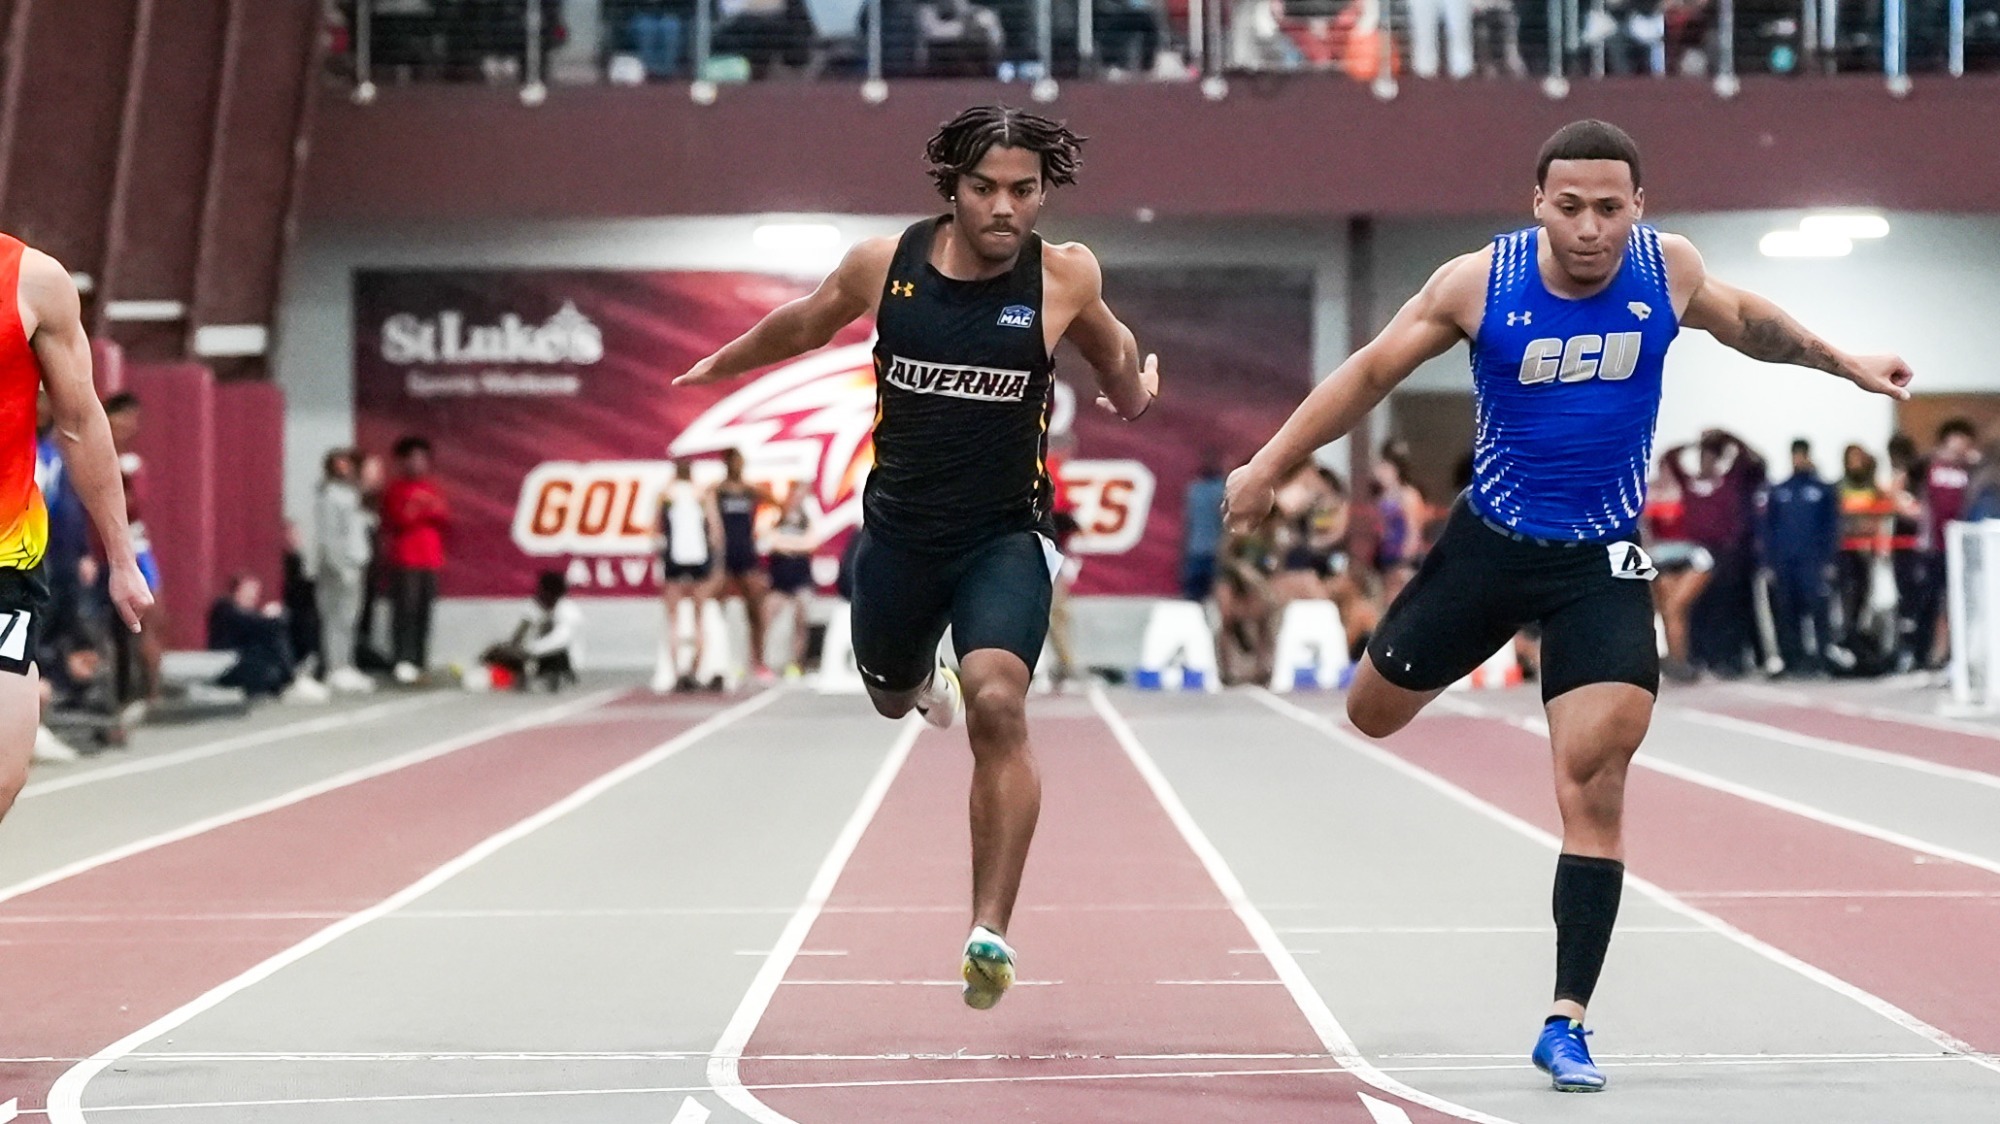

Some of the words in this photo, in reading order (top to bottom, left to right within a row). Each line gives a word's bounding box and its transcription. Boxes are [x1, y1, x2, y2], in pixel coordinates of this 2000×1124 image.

[1000, 314, 1031, 326] MAC
[1518, 331, 1642, 384] CCU
[891, 361, 1026, 398] ALVERNIA
